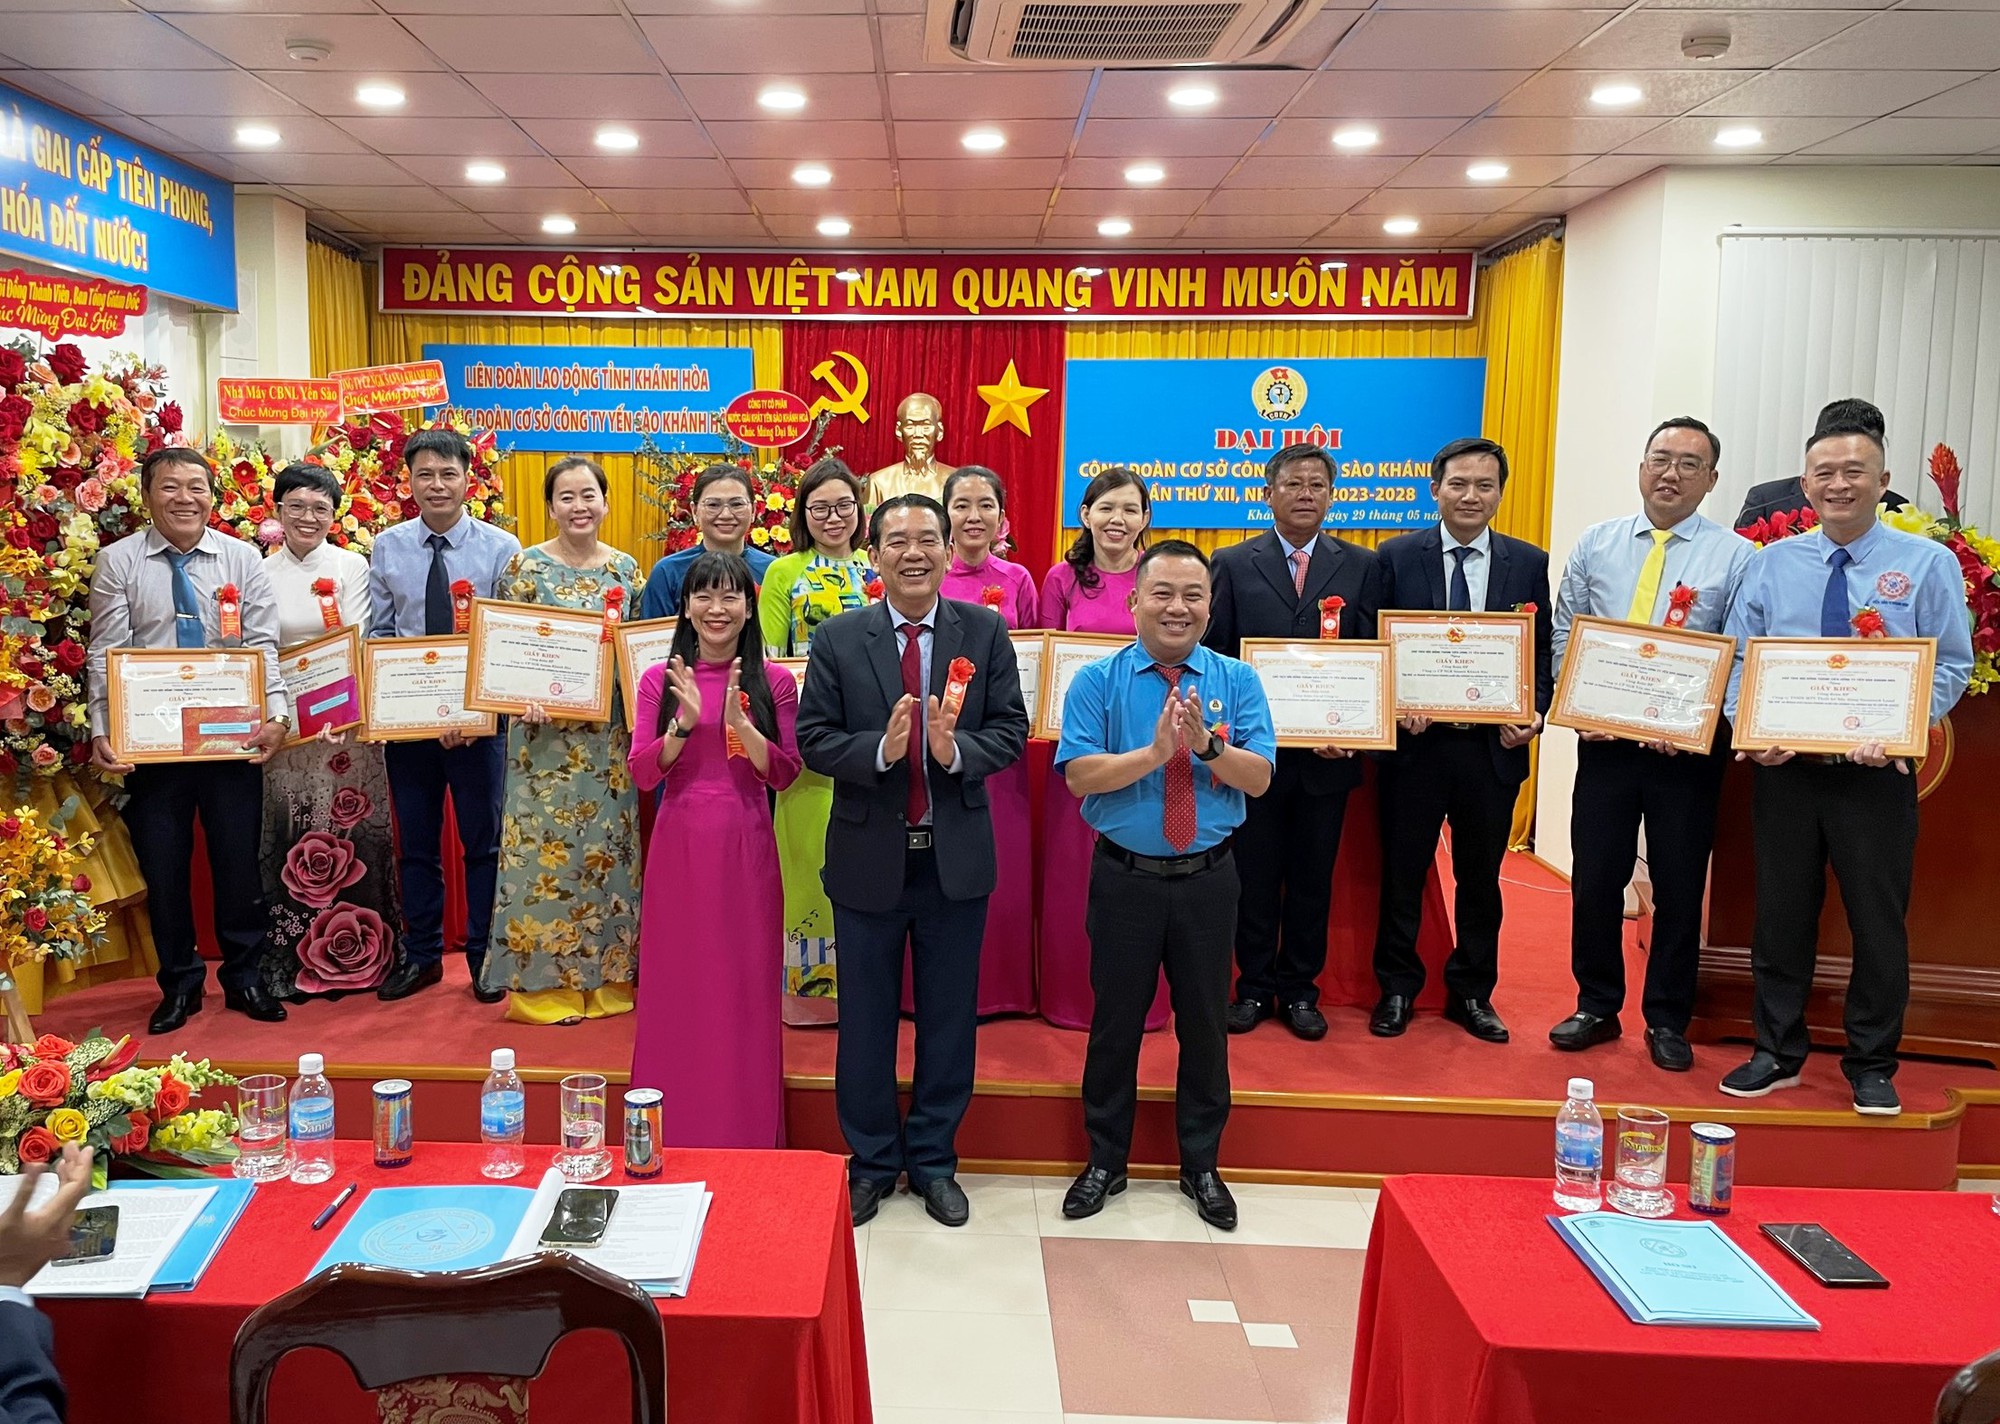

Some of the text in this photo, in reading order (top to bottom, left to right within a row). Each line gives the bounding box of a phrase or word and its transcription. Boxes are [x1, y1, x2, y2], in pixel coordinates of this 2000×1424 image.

[31, 123, 71, 179] GIAI
[76, 135, 113, 193] CẤP
[116, 155, 156, 209] TIÊN
[160, 176, 213, 237] PHONG,
[1, 181, 148, 271] HÓA ĐẤT NƯỚC!
[402, 250, 1458, 314] ĐẢNG CỘNG SẢN VIỆT NAM QUANG VINH MUÔN NĂM
[16, 304, 60, 337] Mừng
[60, 307, 88, 331] Đại
[90, 311, 118, 333] Hội
[465, 360, 711, 397] LIÊN ĐOÀN LAO ĐỘNG TỈNH KHÁNH HÒA
[223, 384, 243, 399] Nhà
[245, 385, 267, 401] Máy
[228, 406, 256, 418] Chúc
[258, 406, 289, 420] Mừng
[291, 407, 308, 419] Đại
[475, 404, 512, 431] ĐOÀN
[515, 408, 533, 431] CƠ
[534, 402, 551, 432] SỞ
[552, 405, 588, 432] CÔNG
[589, 409, 607, 433] TY
[607, 403, 633, 433] YẾN
[634, 405, 661, 433] SÀO
[662, 406, 708, 434] KHÁNH
[1179, 461, 1204, 478] CƠ
[1205, 459, 1229, 478] SỞ
[1230, 460, 1267, 478] CÔN
[1341, 460, 1375, 478] SÀO
[1149, 481, 1173, 502] ẦN
[1175, 482, 1211, 502] THỨ
[1213, 486, 1240, 504] XII,
[1323, 508, 1349, 524] gày
[1351, 509, 1366, 521] 29
[1368, 508, 1404, 524] tháng
[1406, 509, 1421, 521] 05
[1423, 510, 1443, 521] nă
[297, 1118, 334, 1134] Sanna
